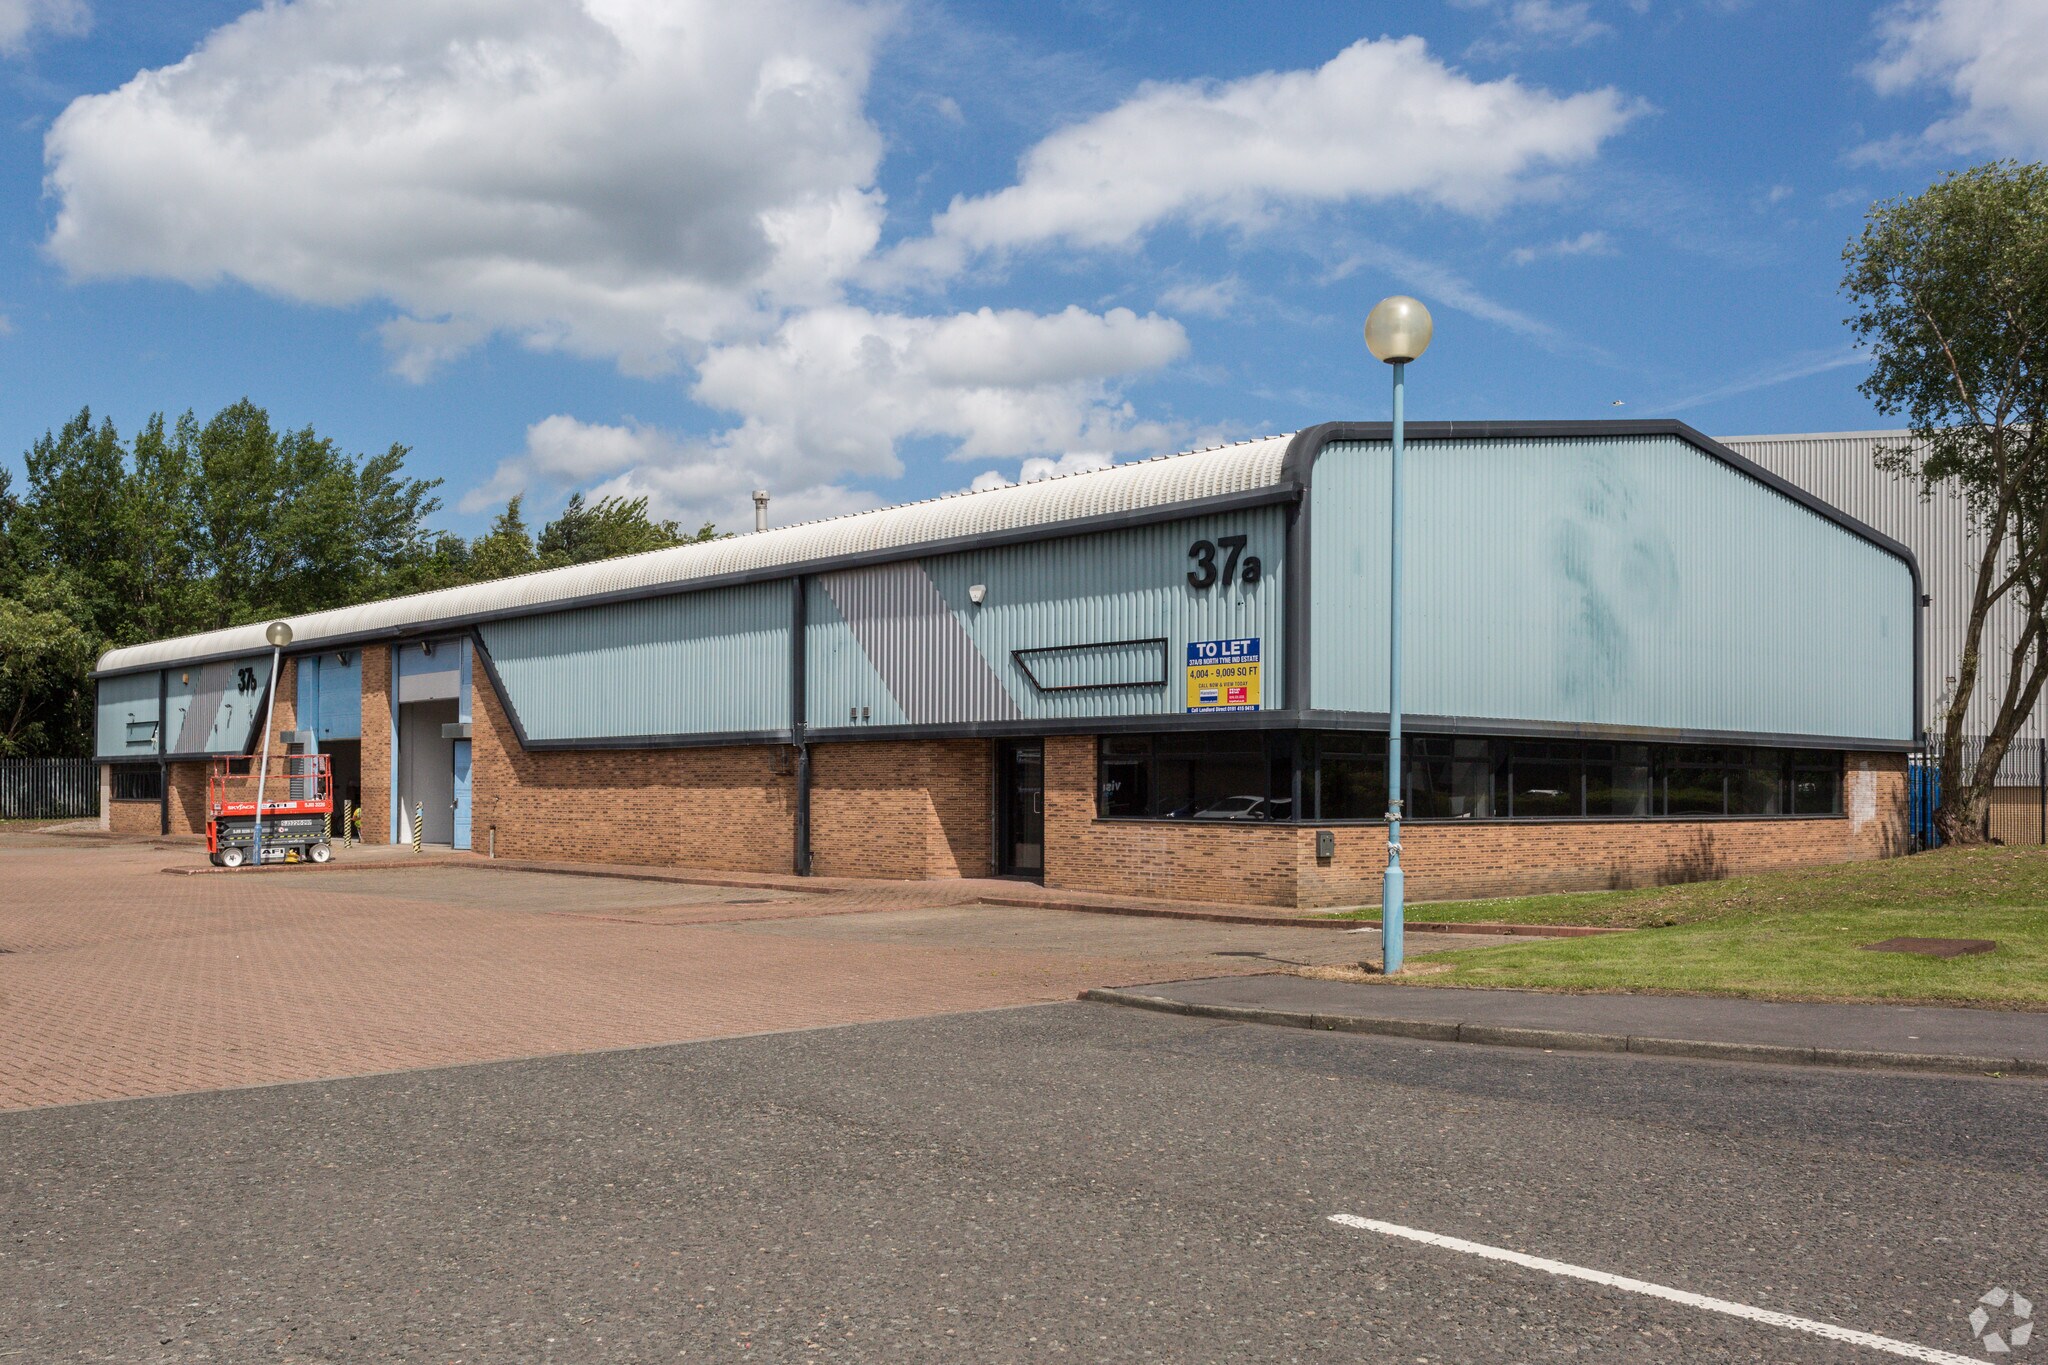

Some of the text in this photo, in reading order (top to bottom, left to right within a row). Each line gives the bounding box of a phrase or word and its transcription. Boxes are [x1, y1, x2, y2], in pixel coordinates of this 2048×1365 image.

[1187, 534, 1261, 589] 37a
[1196, 640, 1250, 657] TO LET
[1190, 670, 1208, 679] 4,004
[1216, 668, 1235, 678] 9,009
[1237, 667, 1246, 676] SQ
[1249, 667, 1257, 675] FT
